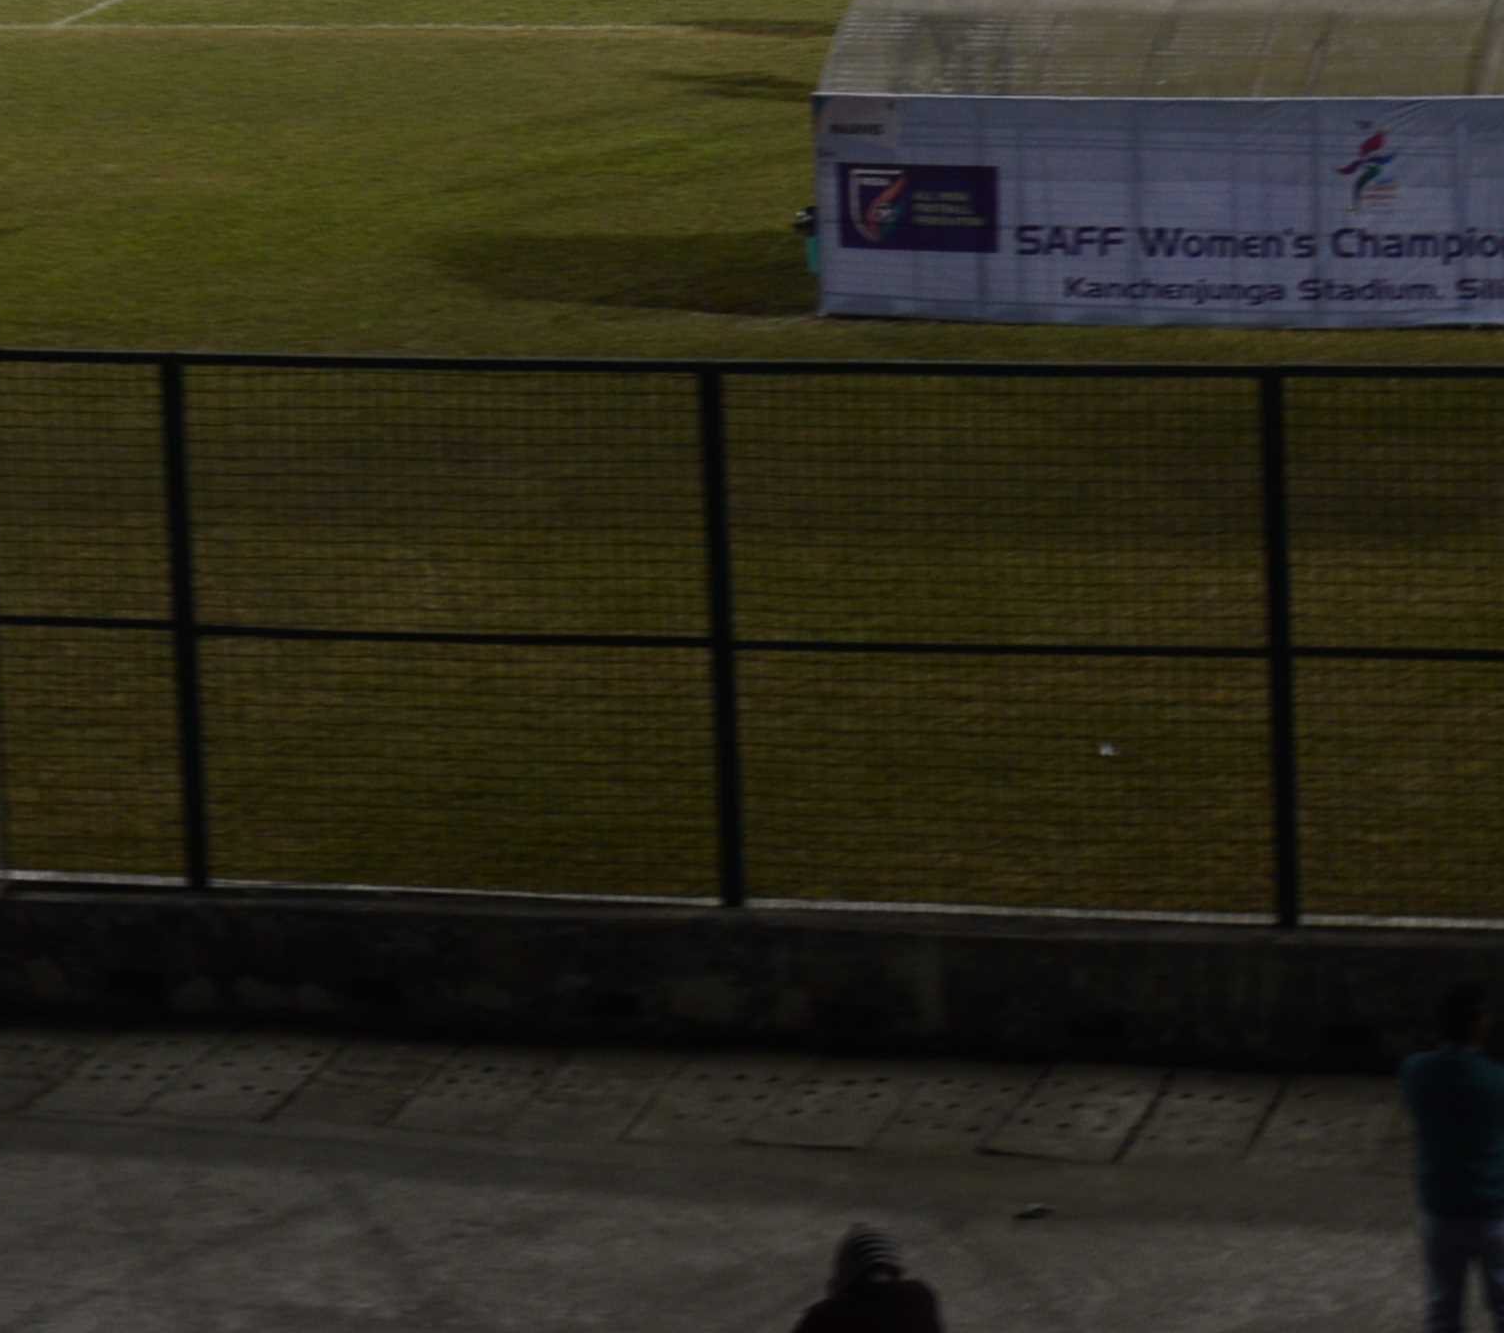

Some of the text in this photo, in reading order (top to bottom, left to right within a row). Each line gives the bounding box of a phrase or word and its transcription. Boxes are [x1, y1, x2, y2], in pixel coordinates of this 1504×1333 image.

[1015, 225, 1125, 256] SAFF
[1137, 226, 1317, 259] Women's
[1063, 276, 1284, 305] Kanchenjunga
